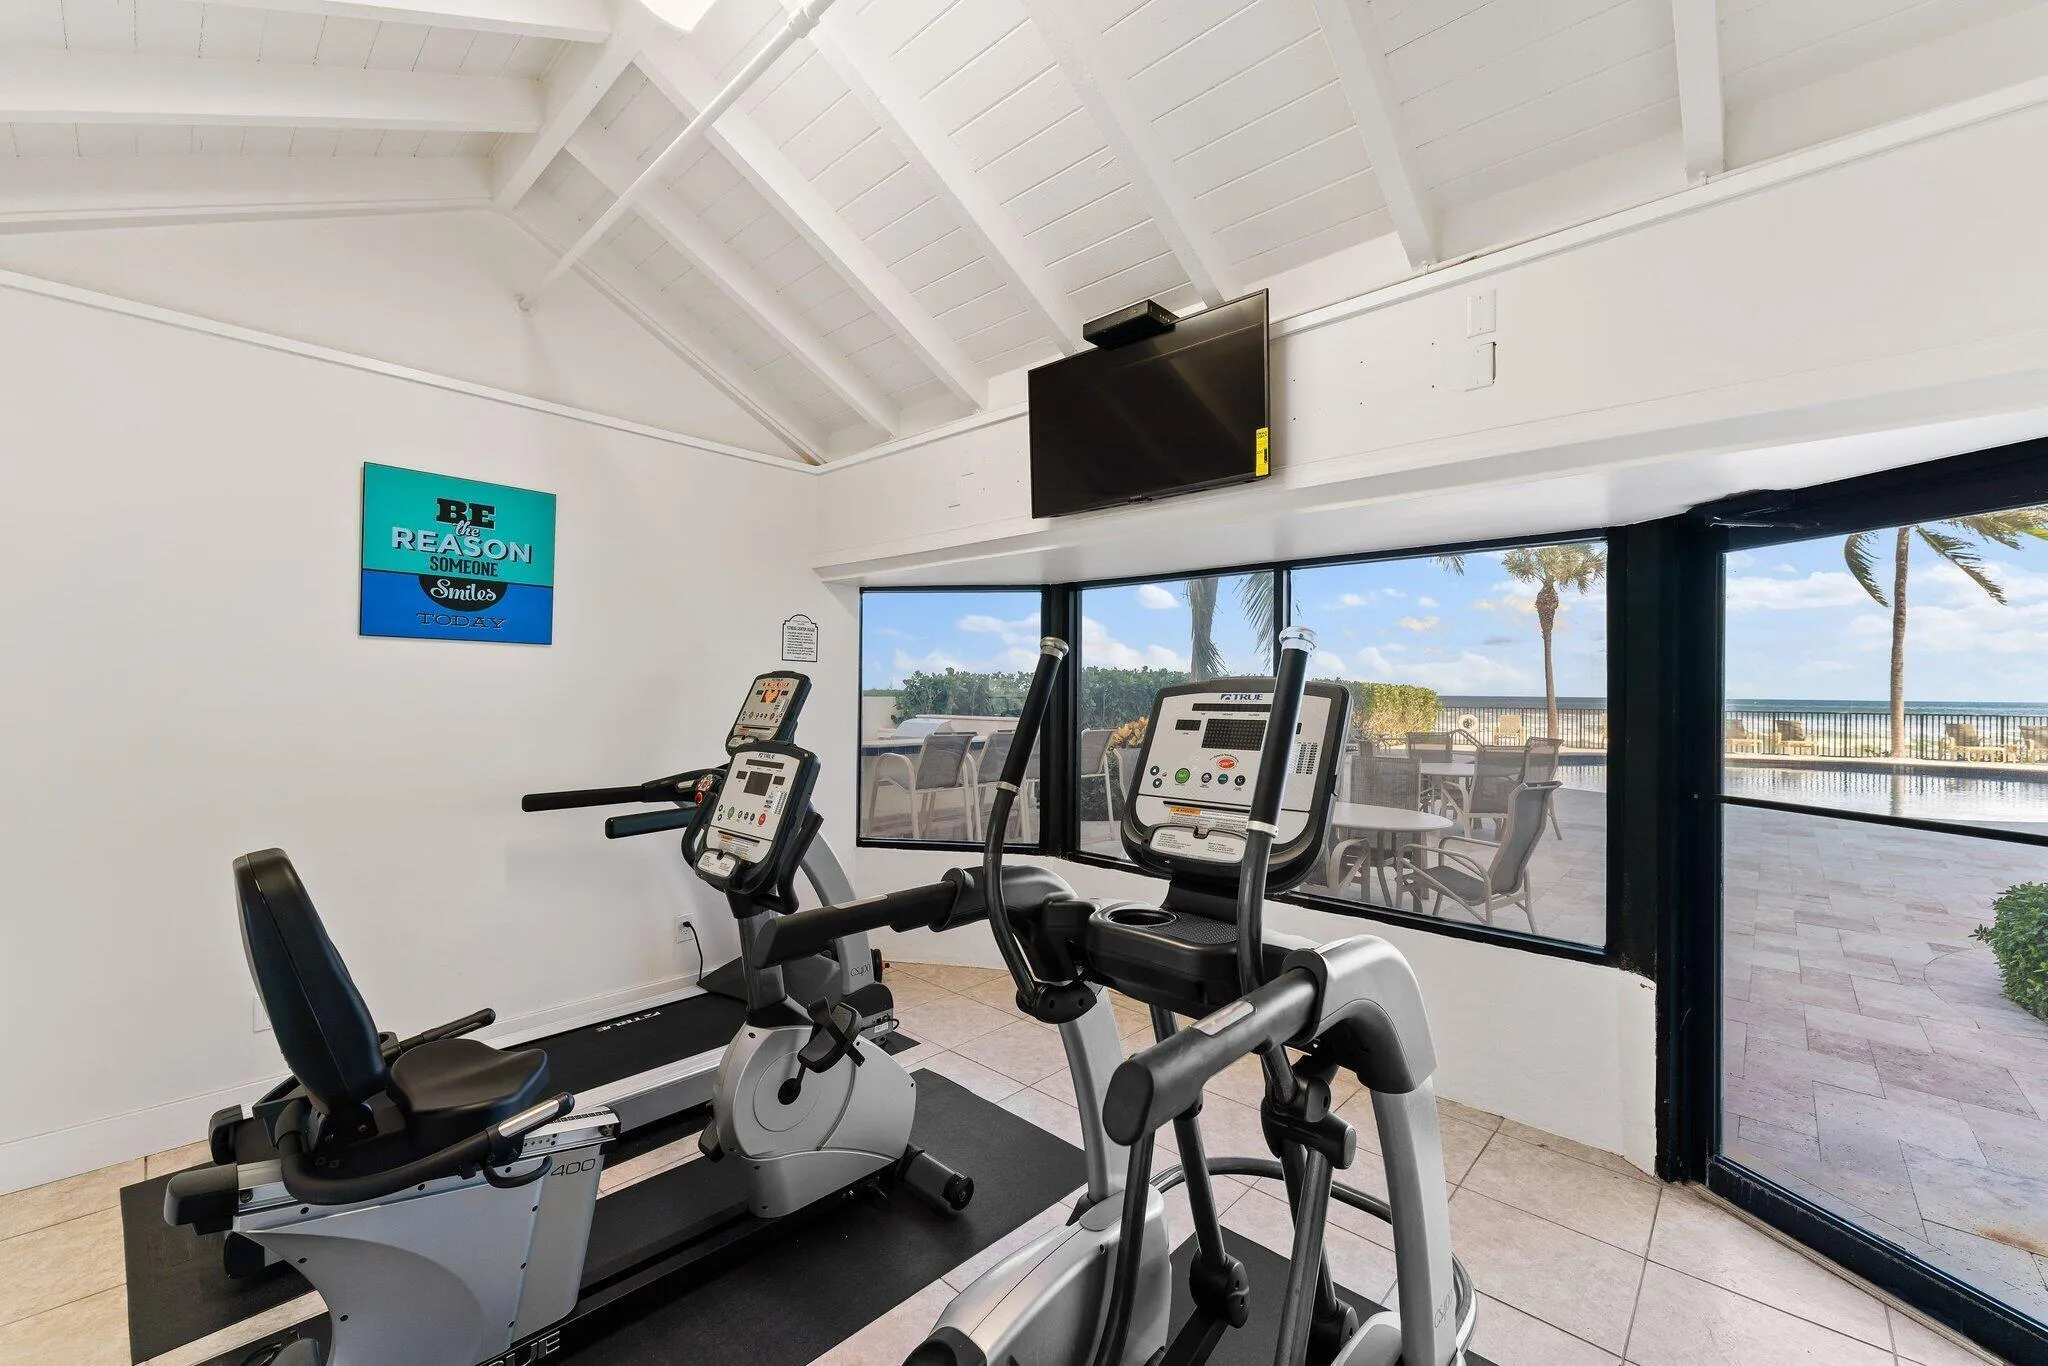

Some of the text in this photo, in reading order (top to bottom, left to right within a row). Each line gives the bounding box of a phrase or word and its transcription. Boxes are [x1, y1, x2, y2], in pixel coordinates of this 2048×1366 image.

[436, 497, 496, 529] BE
[453, 520, 480, 537] the
[391, 526, 533, 564] REASON
[429, 556, 499, 577] SOMEONE
[430, 579, 497, 602] Smiles
[416, 612, 507, 629] TODAY
[1233, 693, 1264, 701] TRUE
[550, 1158, 596, 1177] 400
